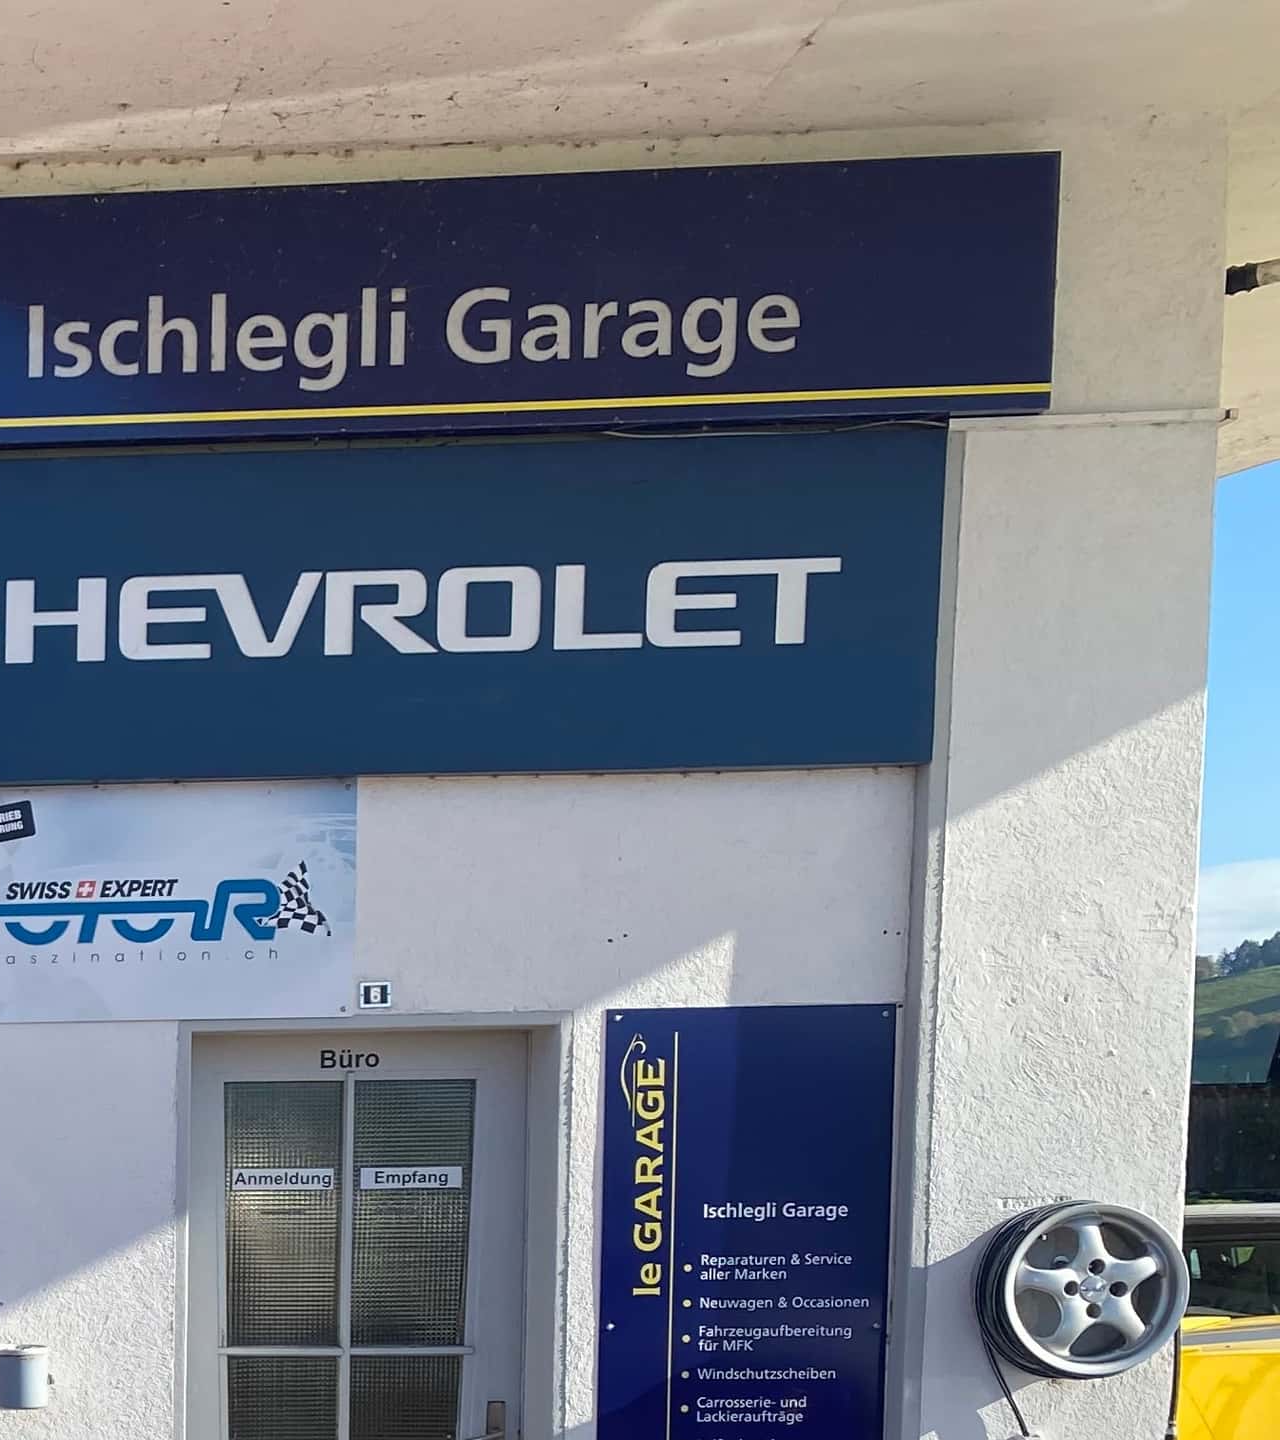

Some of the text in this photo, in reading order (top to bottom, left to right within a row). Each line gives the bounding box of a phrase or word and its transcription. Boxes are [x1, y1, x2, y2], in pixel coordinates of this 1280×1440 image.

[27, 284, 801, 392] Ischlegli Garage
[6, 878, 179, 900] SWISS EXPERT
[370, 986, 381, 1002] 6
[319, 1049, 380, 1069] Büro
[234, 1170, 449, 1189] Anmeldung Empfang
[633, 1058, 666, 1296] le GARAGE
[703, 1202, 849, 1221] Ischlegli Garage
[700, 1253, 852, 1268] Reparaturen & Service
[700, 1268, 787, 1280] aller Marken
[699, 1296, 869, 1313] Neuwagen & Occasionen
[698, 1324, 852, 1340] Fahrzeugaufbereitung
[698, 1339, 754, 1352] für MFK
[697, 1367, 836, 1380] Windschutzscheiben
[696, 1396, 807, 1409] Carrosserie- und
[696, 1410, 803, 1425] Lackieraufträge
